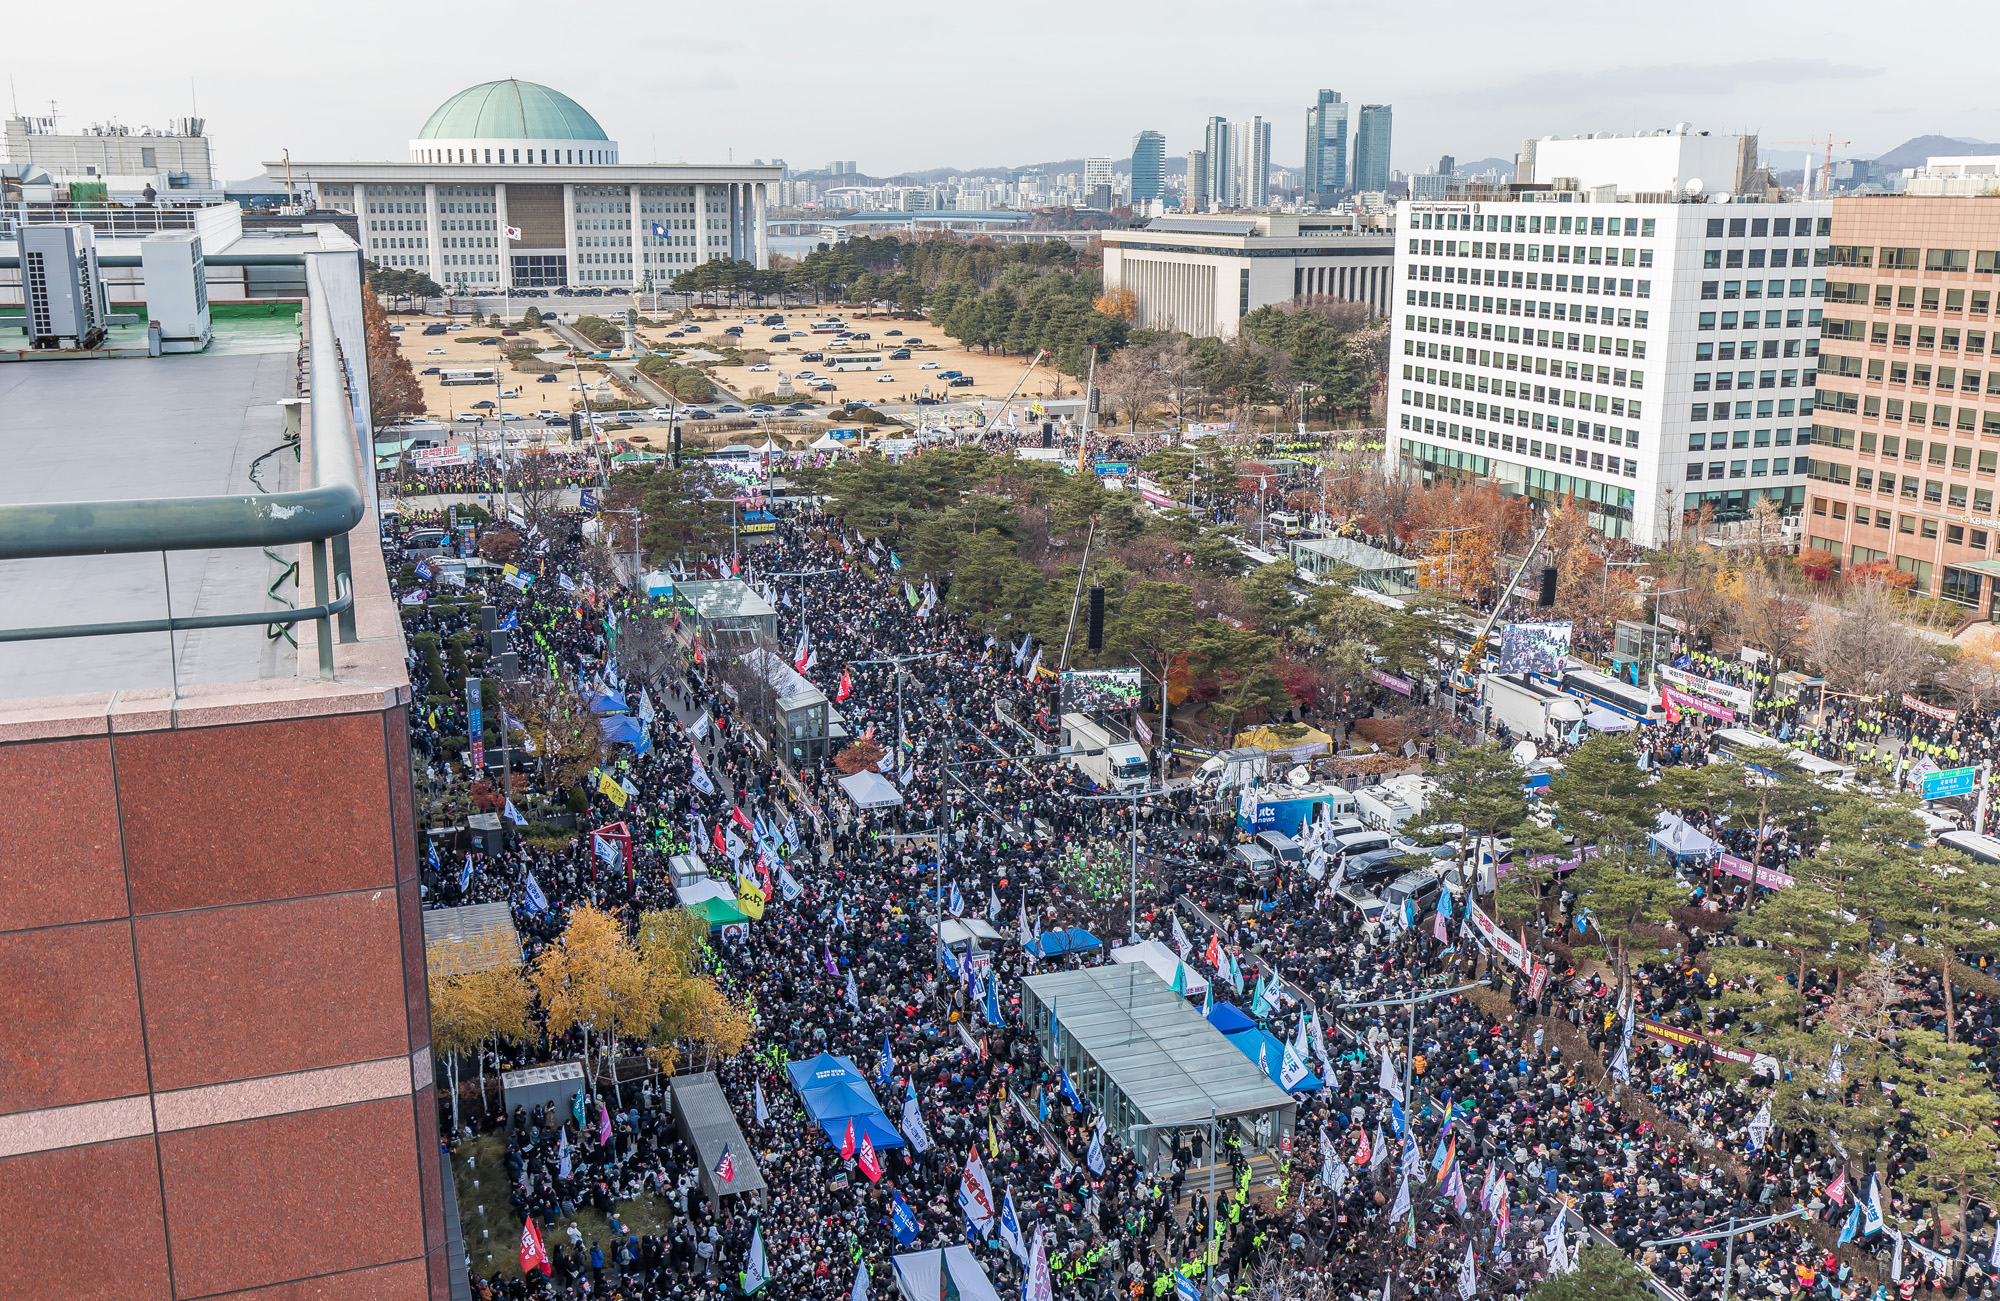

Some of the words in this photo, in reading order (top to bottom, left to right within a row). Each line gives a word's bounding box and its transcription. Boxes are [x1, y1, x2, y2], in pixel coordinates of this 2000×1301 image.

[875, 799, 894, 807] 의료부스
[1258, 816, 1276, 824] news
[1368, 811, 1388, 831] SBS
